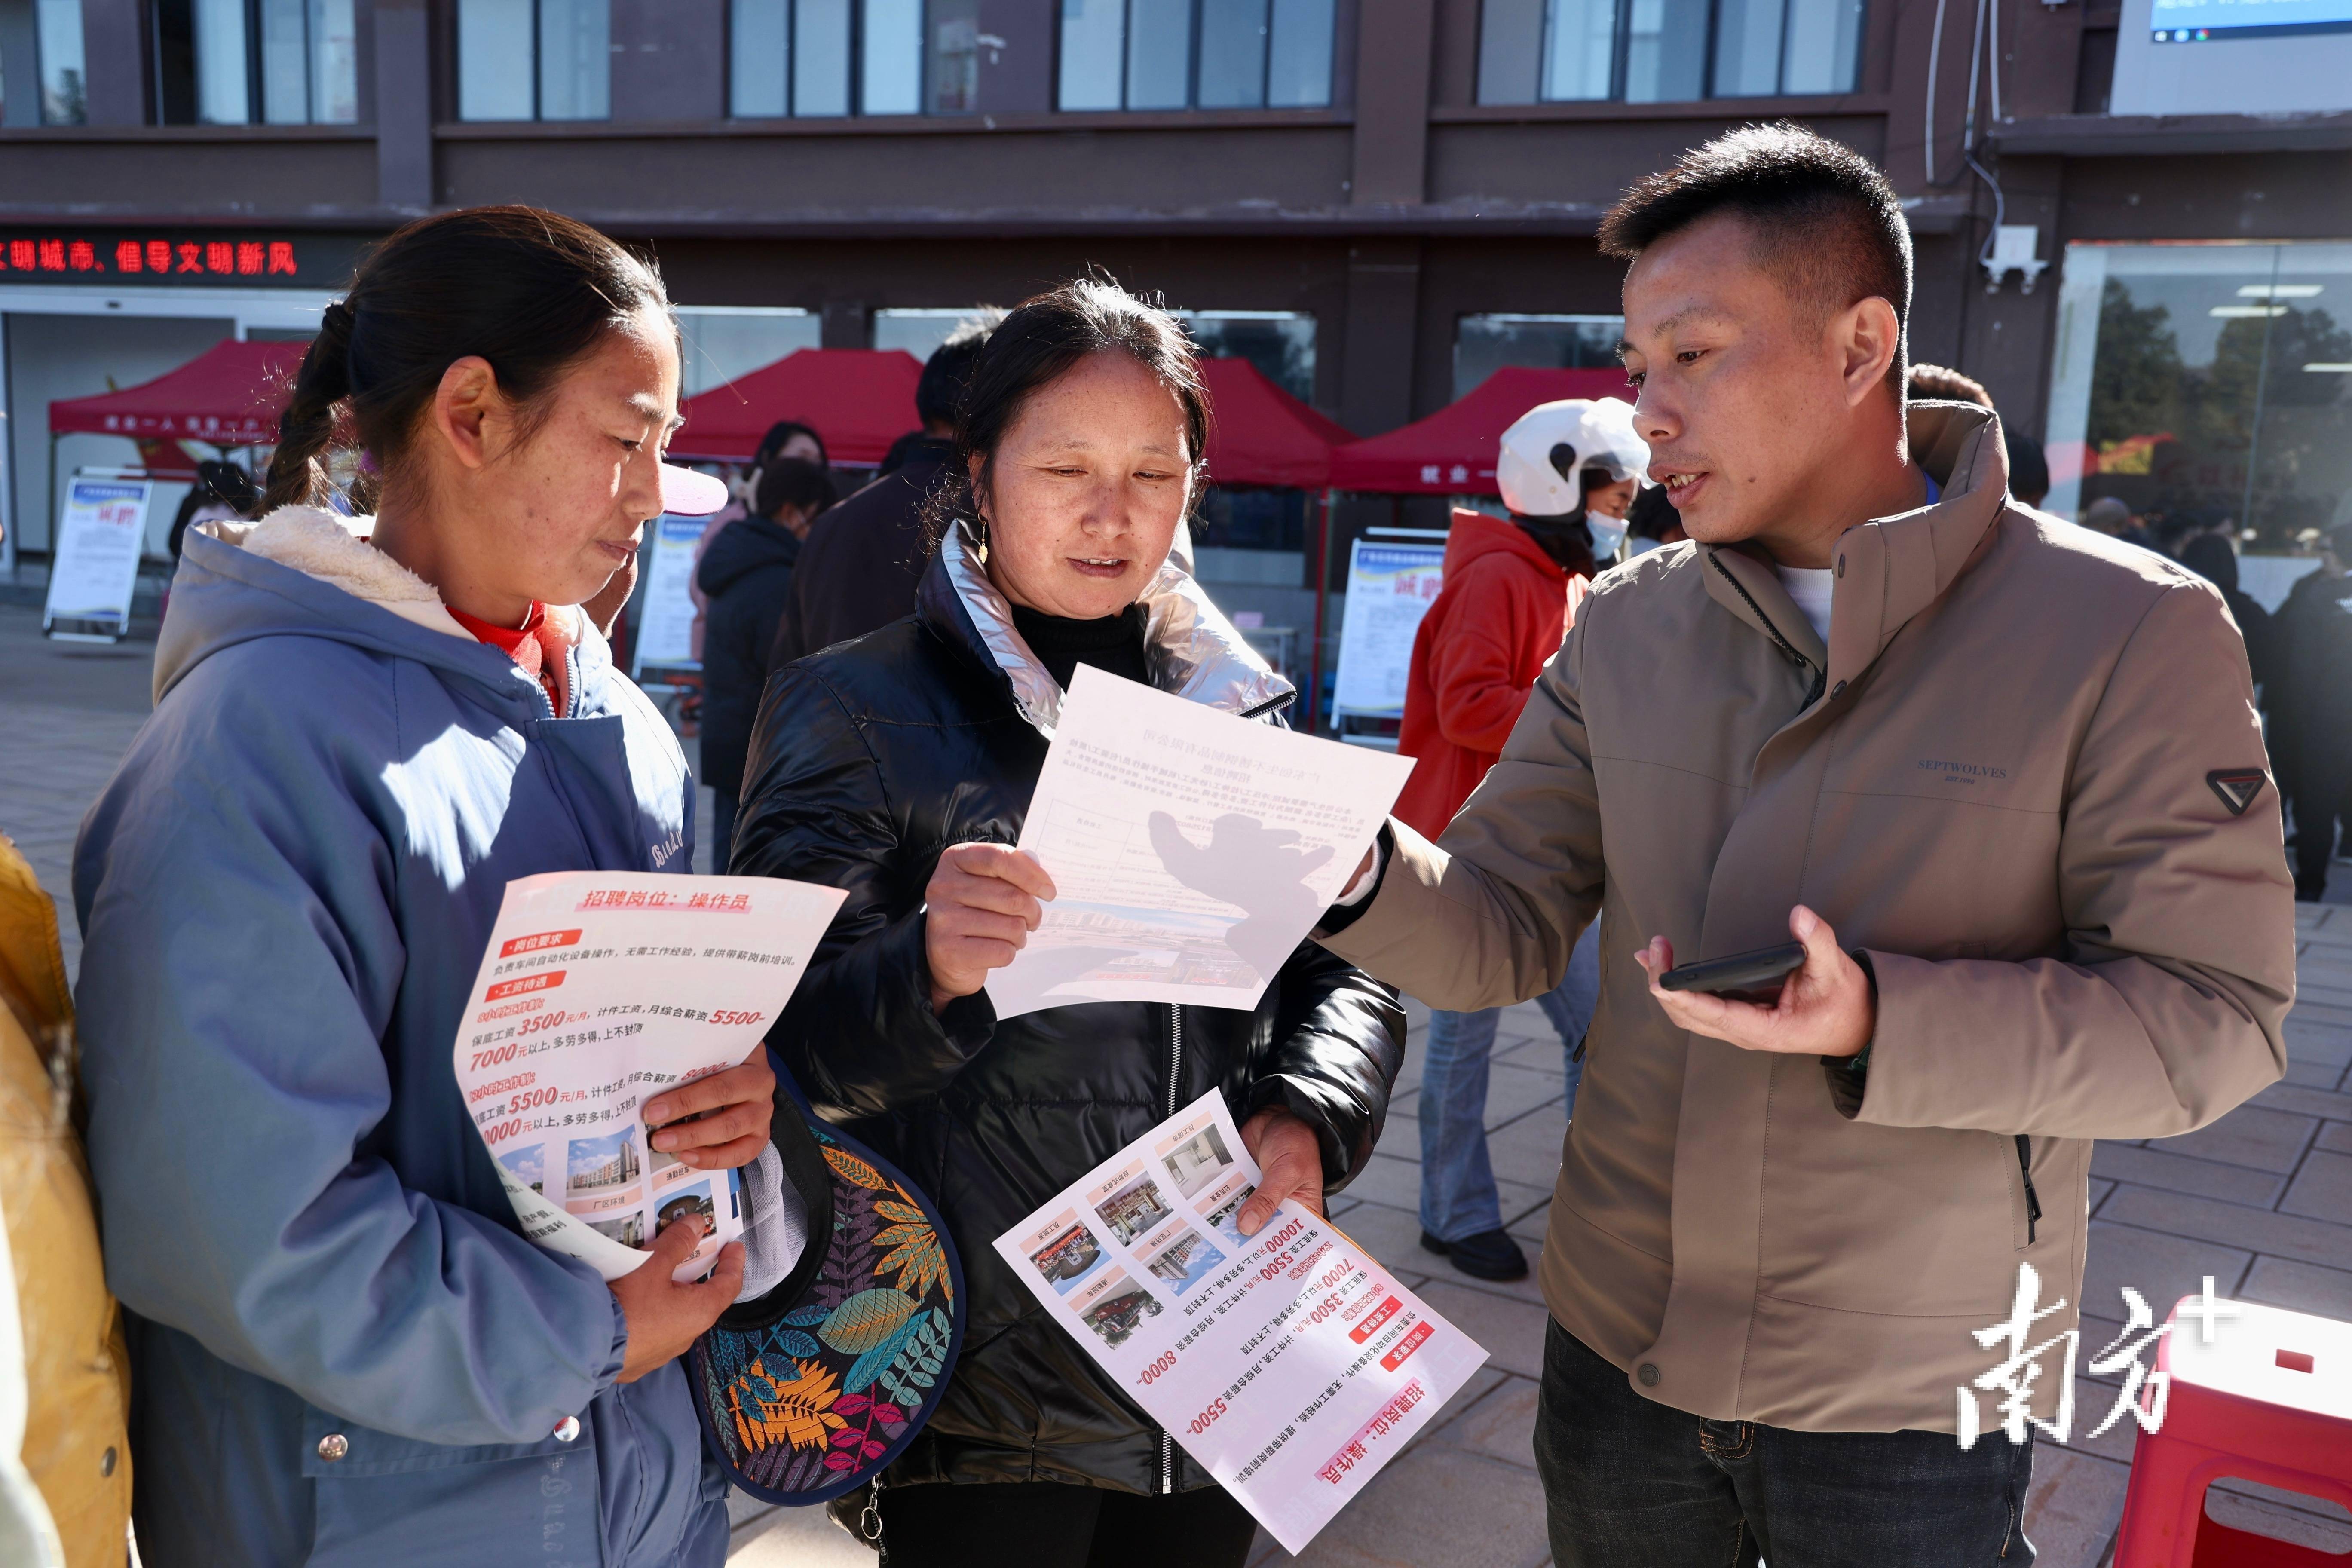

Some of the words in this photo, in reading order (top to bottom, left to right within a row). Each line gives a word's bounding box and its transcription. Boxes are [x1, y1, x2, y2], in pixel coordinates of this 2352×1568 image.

[1917, 760, 2006, 778] SEPTWOLVES
[582, 889, 750, 910] 招聘岗位：操作员
[1173, 1124, 1194, 1142] 员工宿舍
[666, 1166, 690, 1182] 通勤班车
[1101, 1170, 1130, 1193] 自助式食堂
[593, 1196, 625, 1209] 厂区环境
[1210, 1184, 1231, 1202] 公司全景
[1037, 1221, 1060, 1240] 员工旅游
[1149, 1229, 1172, 1248] 厂区环境
[1086, 1278, 1109, 1298] 通勤班车
[1321, 1383, 1426, 1485] 招聘岗位：操作员
